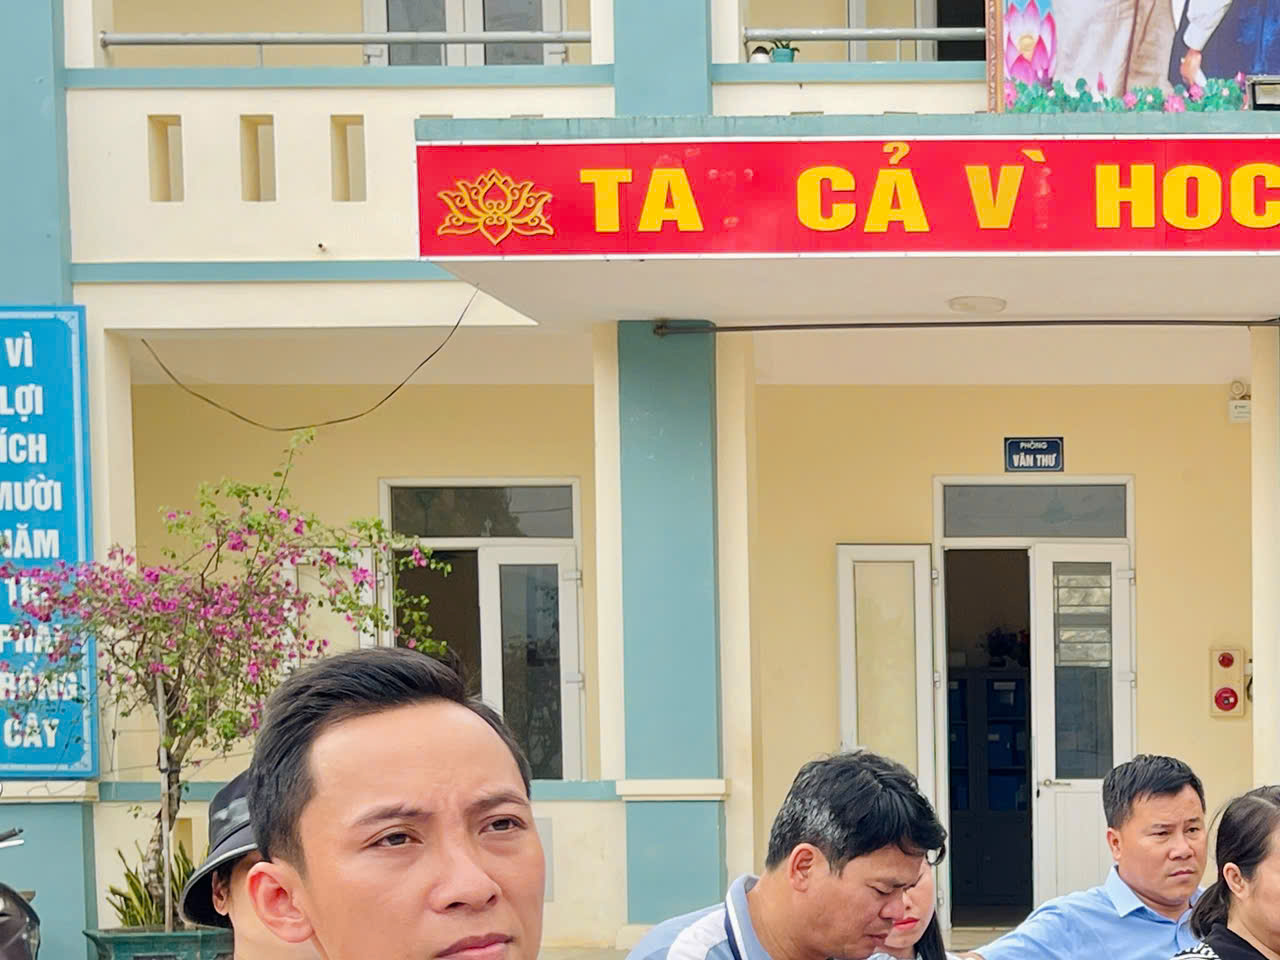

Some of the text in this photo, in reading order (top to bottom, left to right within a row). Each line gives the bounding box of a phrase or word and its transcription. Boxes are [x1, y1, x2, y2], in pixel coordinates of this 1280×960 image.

[796, 141, 931, 232] CẢ
[5, 331, 33, 368] VÌ
[0, 383, 44, 422] LỢI
[1012, 452, 1057, 467] VĂN THƯ
[3, 712, 59, 748] CÂY
